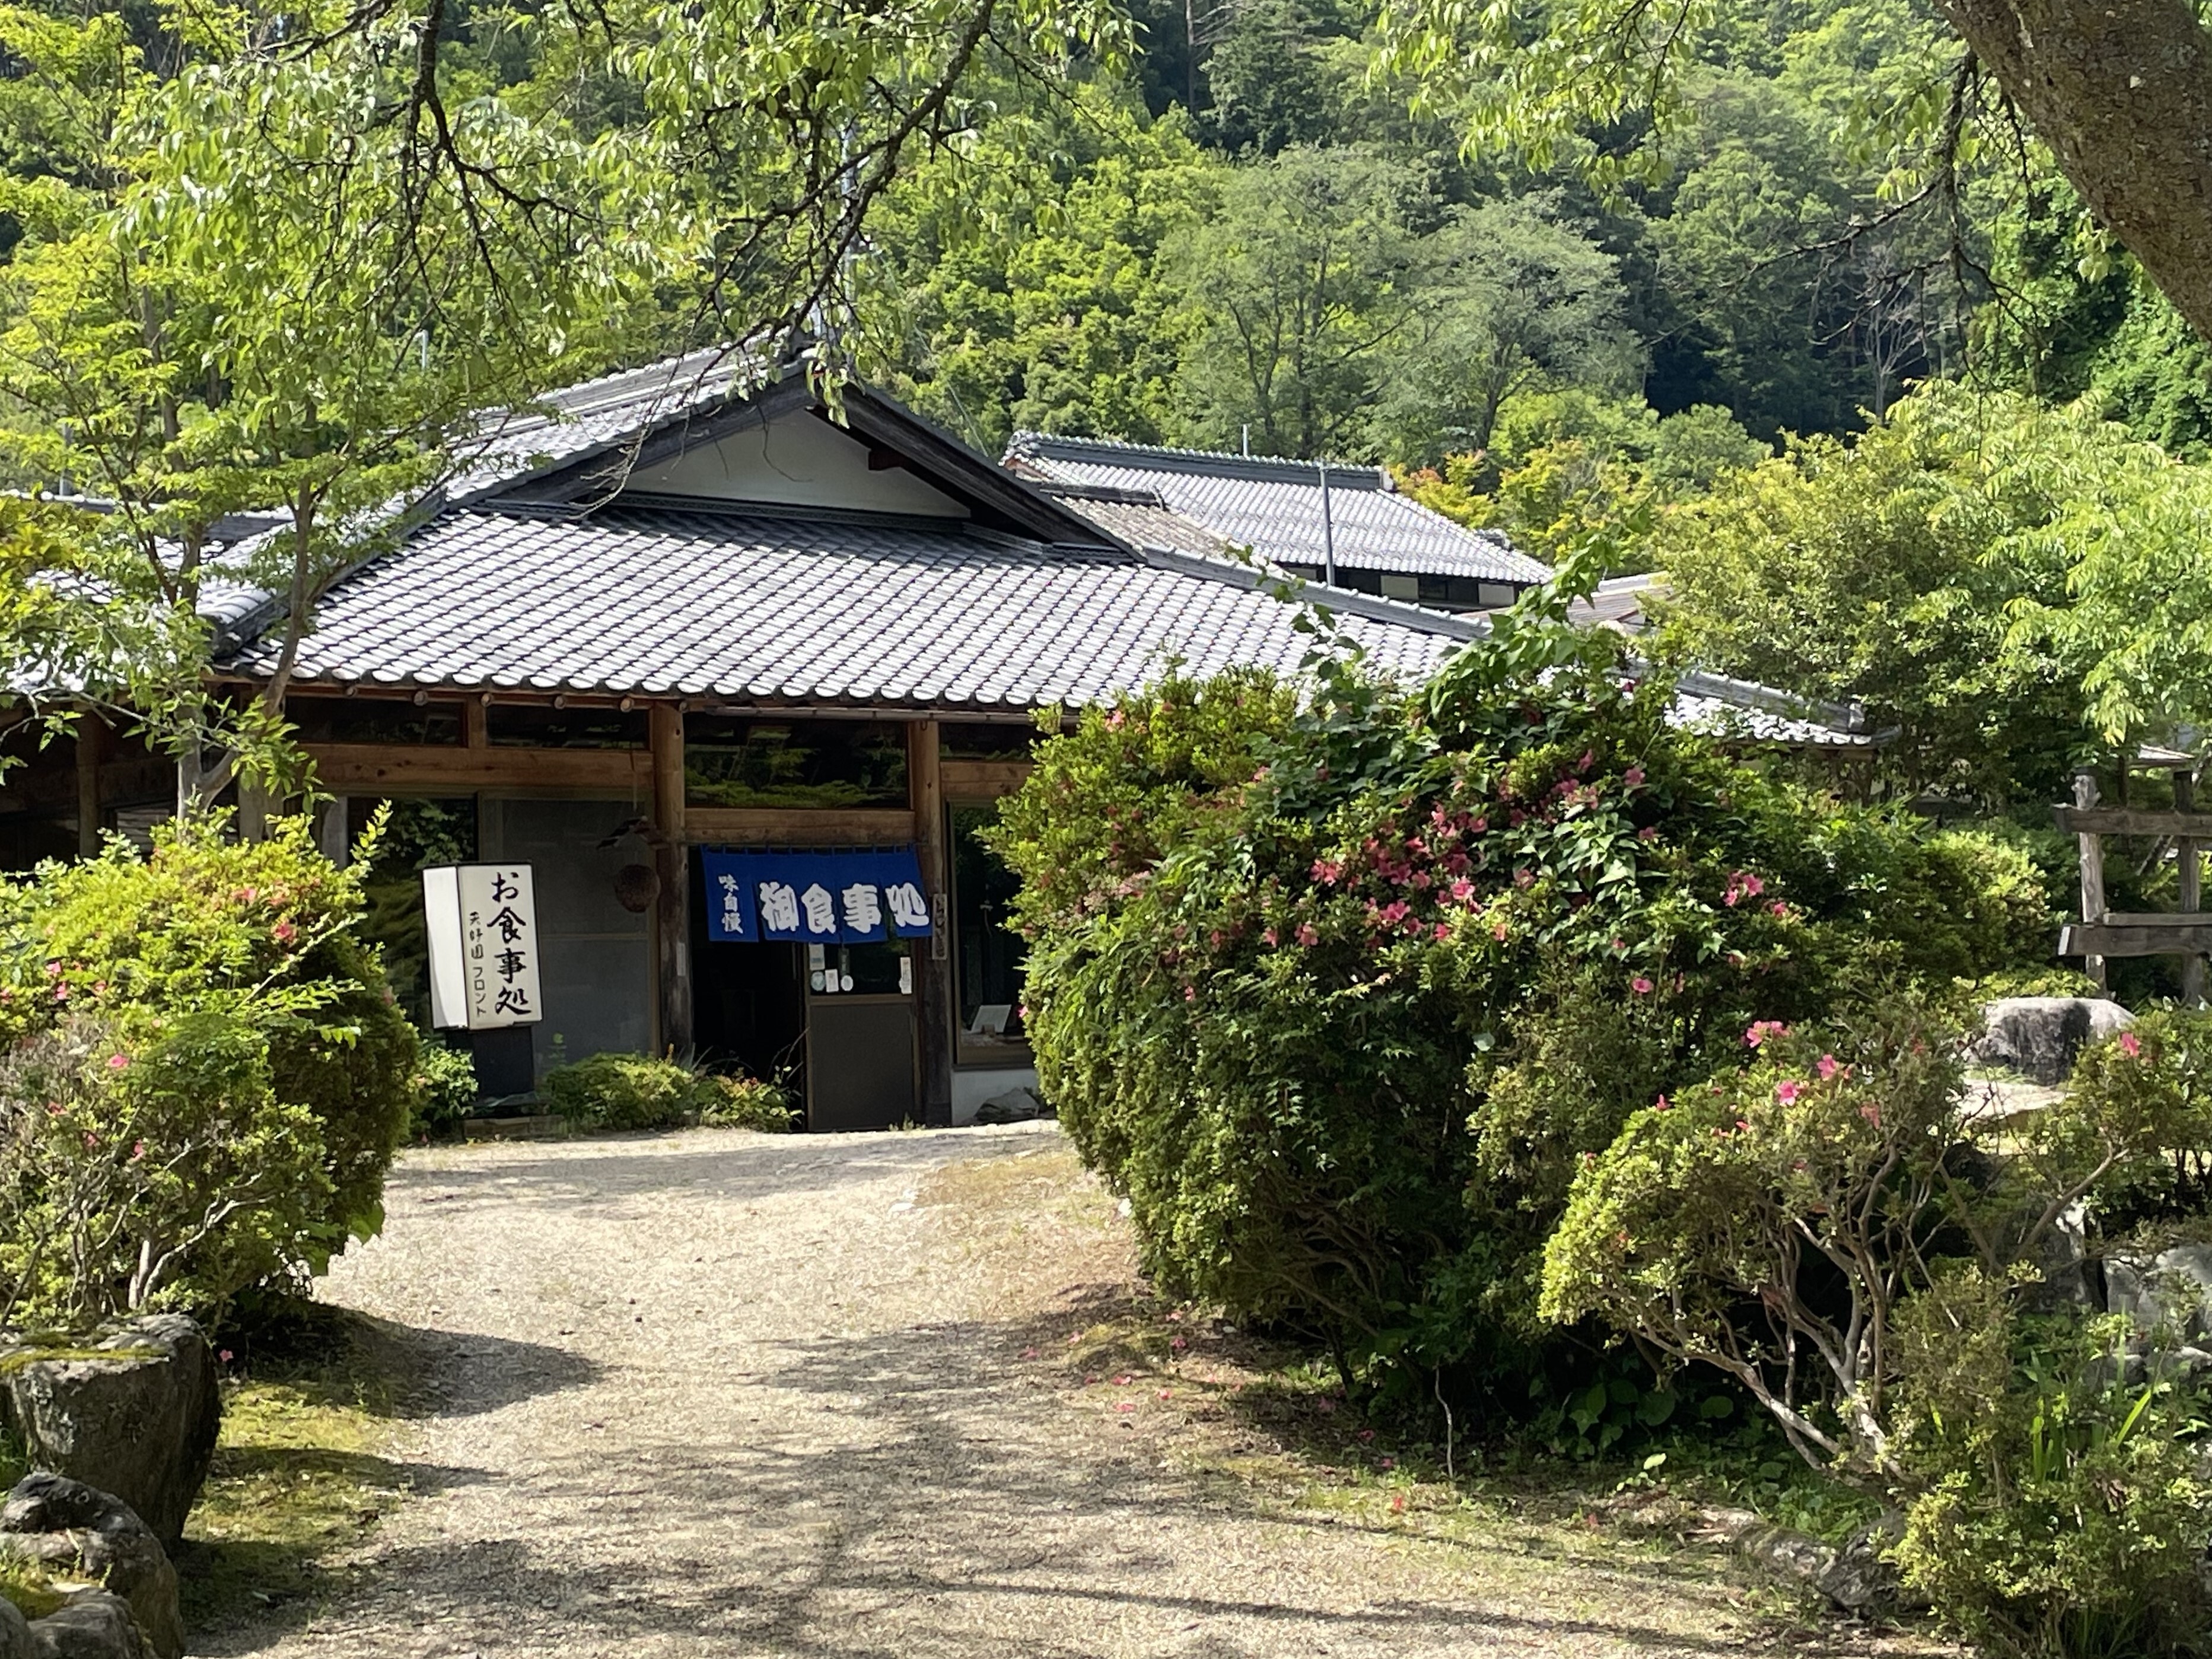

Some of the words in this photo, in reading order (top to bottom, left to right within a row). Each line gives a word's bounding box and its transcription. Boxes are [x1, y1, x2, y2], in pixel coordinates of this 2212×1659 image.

[718, 874, 743, 934] 味自慢
[759, 881, 930, 934] 御食事処
[486, 871, 532, 1015] お食事処
[473, 966, 486, 1018] フロント
